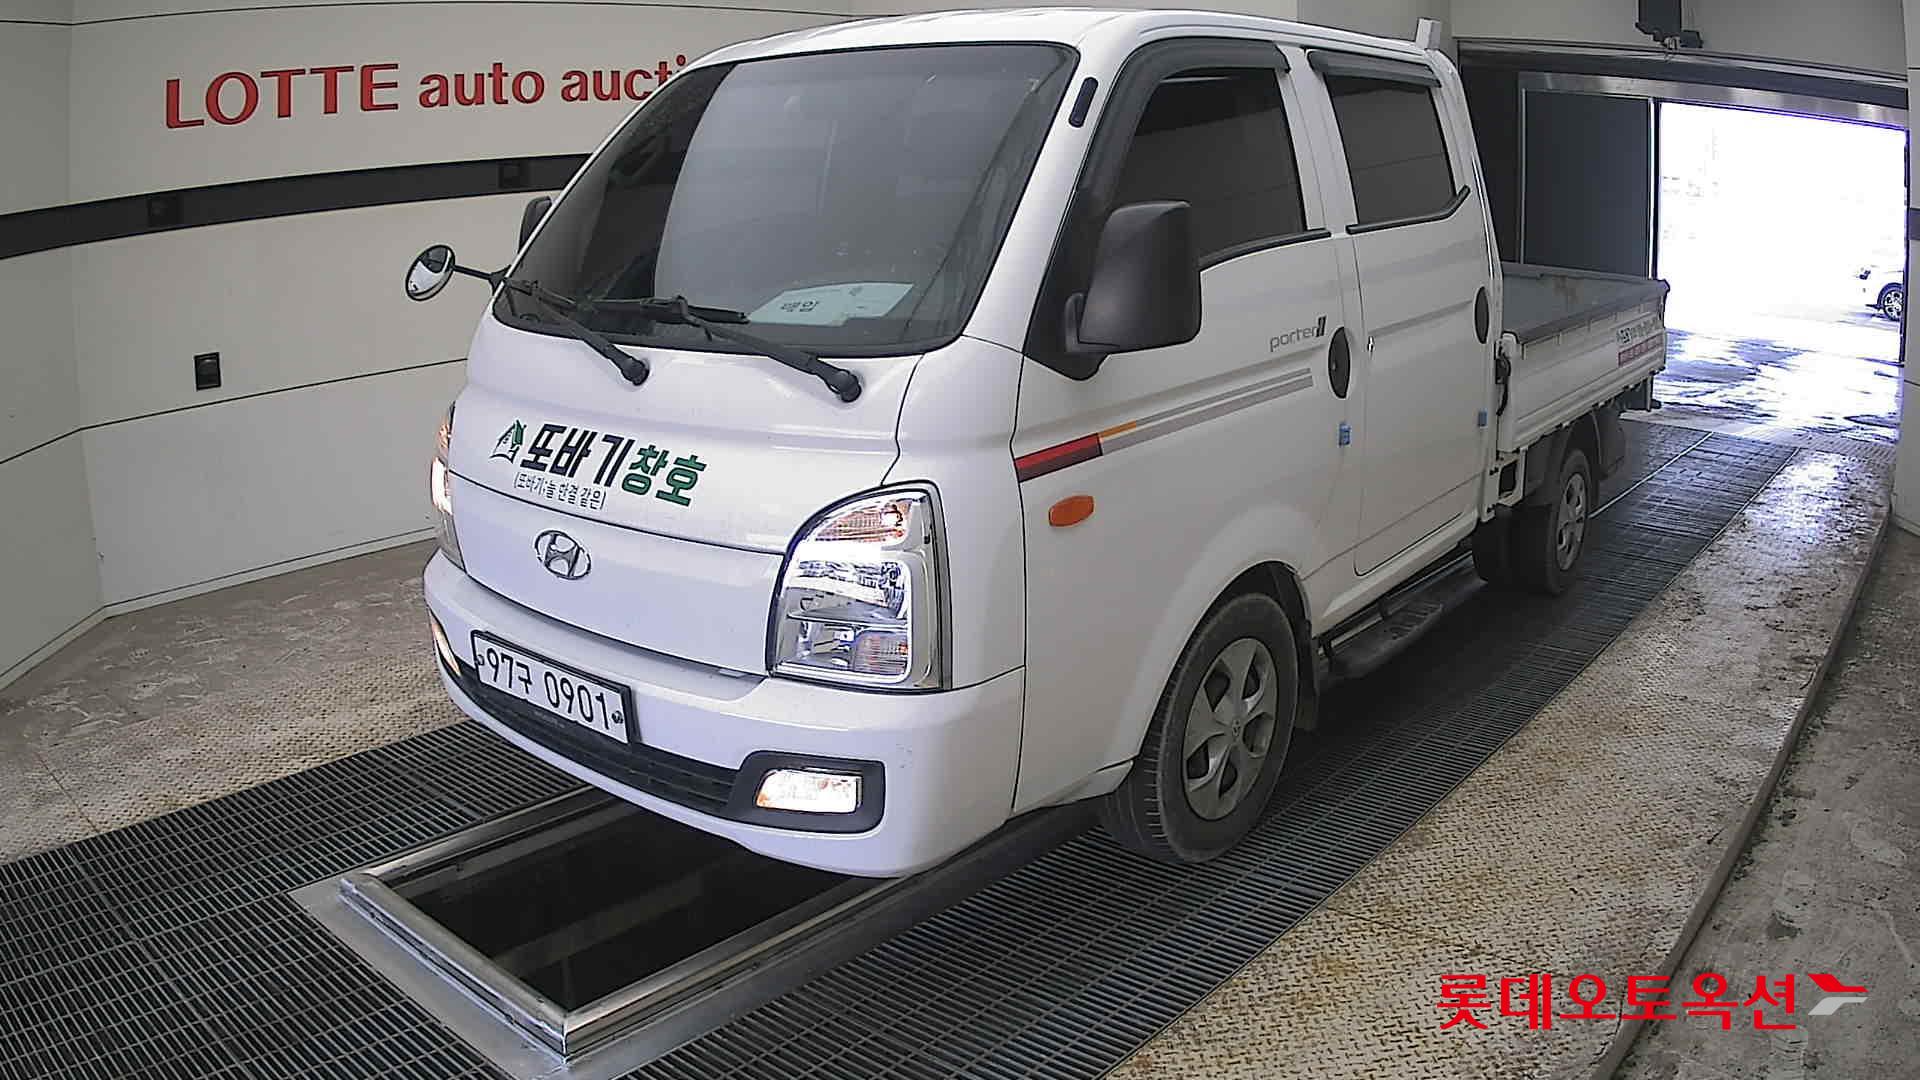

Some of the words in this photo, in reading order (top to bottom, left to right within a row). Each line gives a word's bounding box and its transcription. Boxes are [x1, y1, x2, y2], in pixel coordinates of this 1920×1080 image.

[166, 63, 398, 129] LOTTE
[416, 62, 545, 108] auto
[520, 423, 707, 507] 또바기창호
[486, 648, 533, 694] 97구
[544, 671, 609, 730] 0901
